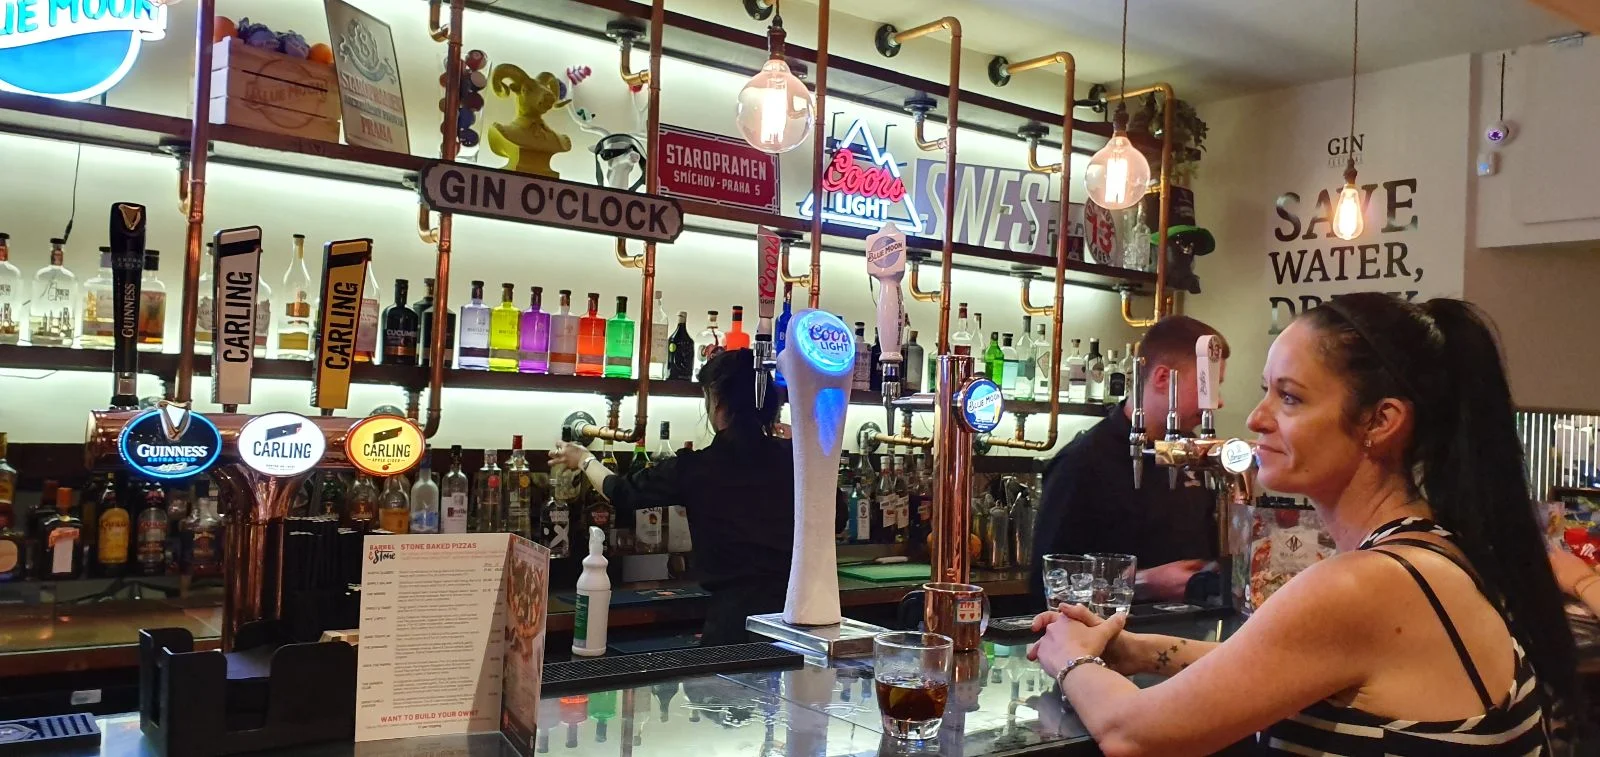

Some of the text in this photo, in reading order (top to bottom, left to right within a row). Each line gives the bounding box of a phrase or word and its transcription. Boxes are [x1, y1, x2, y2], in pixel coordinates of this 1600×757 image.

[1328, 133, 1365, 156] GIN
[666, 143, 767, 181] STAROPRAMEN
[673, 167, 716, 188] SMÍCHOV
[721, 178, 751, 195] PRAHA
[754, 184, 761, 197] 5
[823, 148, 908, 203] Coors
[438, 169, 669, 235] GIN O'CLOCK
[835, 192, 890, 220] LIGHT
[867, 241, 903, 263] BLUE MOON
[1268, 241, 1424, 285] WATER,
[759, 235, 781, 298] Coors
[121, 283, 136, 338] GUINNESS
[223, 271, 252, 363] CARLING
[325, 281, 358, 370] CARLING
[820, 341, 849, 353] LIGHT
[968, 393, 1001, 412] BLUE MOON
[136, 443, 208, 458] GUINNESS
[253, 440, 311, 459] CARLING
[363, 443, 411, 458] CARLING
[373, 549, 396, 564] Stone
[400, 543, 425, 551] STONE
[451, 542, 477, 550] PIZZAS
[380, 715, 402, 723] WANT
[414, 712, 436, 720] BUILD
